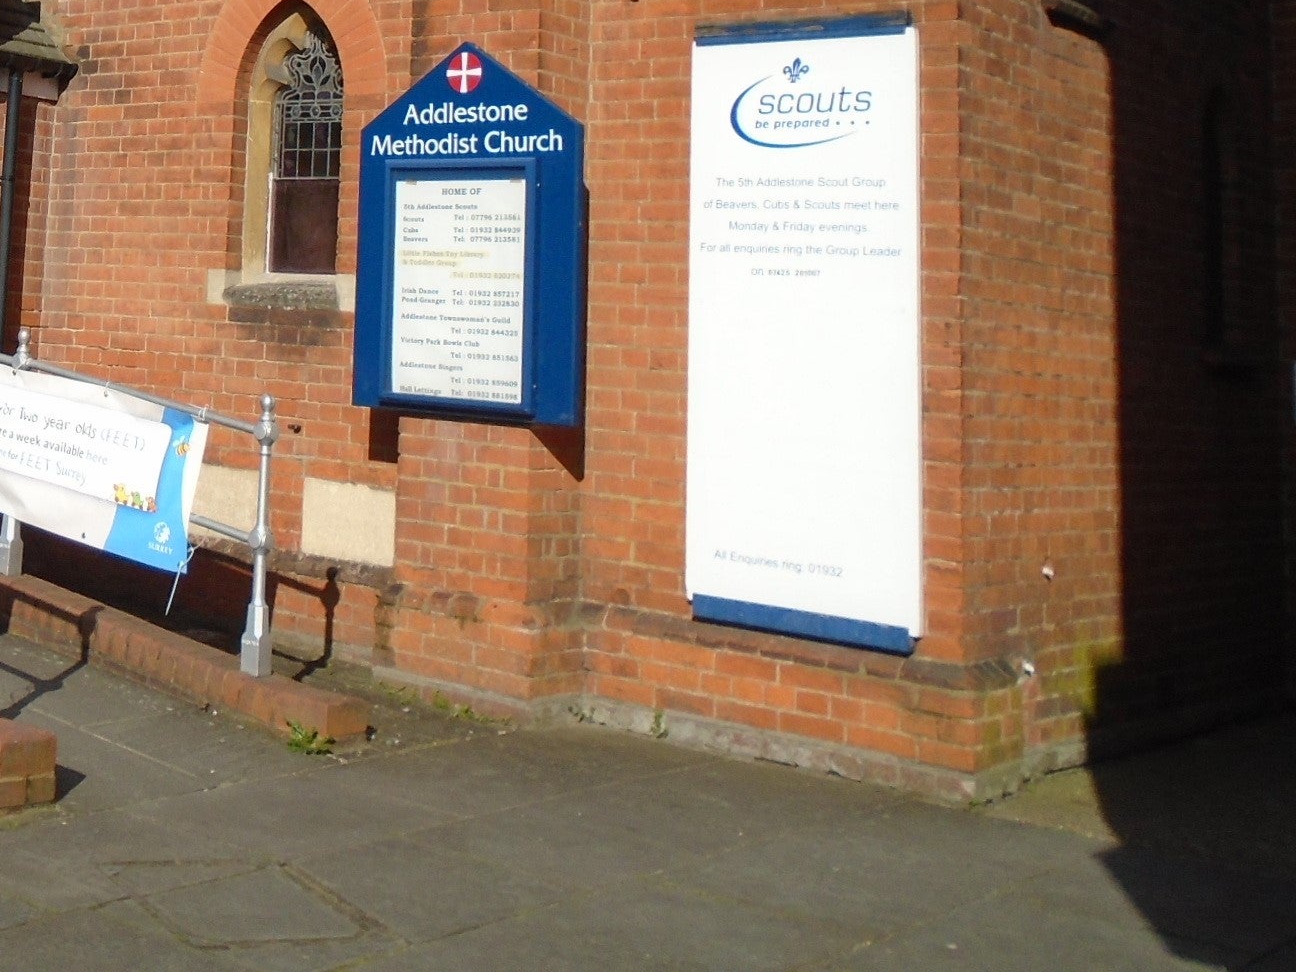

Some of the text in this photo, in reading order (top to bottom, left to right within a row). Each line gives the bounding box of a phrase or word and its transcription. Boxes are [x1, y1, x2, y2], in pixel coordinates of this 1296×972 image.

[758, 87, 872, 115] scouts
[402, 101, 528, 126] Addlestone
[755, 118, 830, 130] be prepared
[370, 128, 564, 157] Methodist Church
[715, 177, 886, 188] The 5th Addlestone Scout Group
[442, 188, 482, 196] HOME OF
[703, 199, 714, 209] of
[762, 199, 790, 210] Cubs
[792, 199, 801, 210] &
[803, 199, 841, 210] Scouts
[843, 199, 872, 210] meet
[873, 199, 900, 211] here
[728, 220, 868, 234] Monday & Friday evenings
[699, 242, 901, 257] For all enquiries ring the Group Leader
[401, 336, 424, 345] Victory
[400, 361, 436, 369] Addlestone
[467, 378, 489, 386] 01932
[19, 406, 39, 423] Two
[43, 415, 72, 431] year
[75, 422, 97, 439] olds
[100, 429, 146, 452] (FEET)
[8, 430, 15, 439] a
[16, 432, 42, 447] week
[43, 439, 85, 459] available
[85, 449, 109, 466] here
[19, 451, 52, 472] FEET
[55, 461, 87, 488] Surrey
[714, 549, 727, 560] All
[729, 550, 779, 569] Enquiries
[808, 562, 844, 578] 01932
